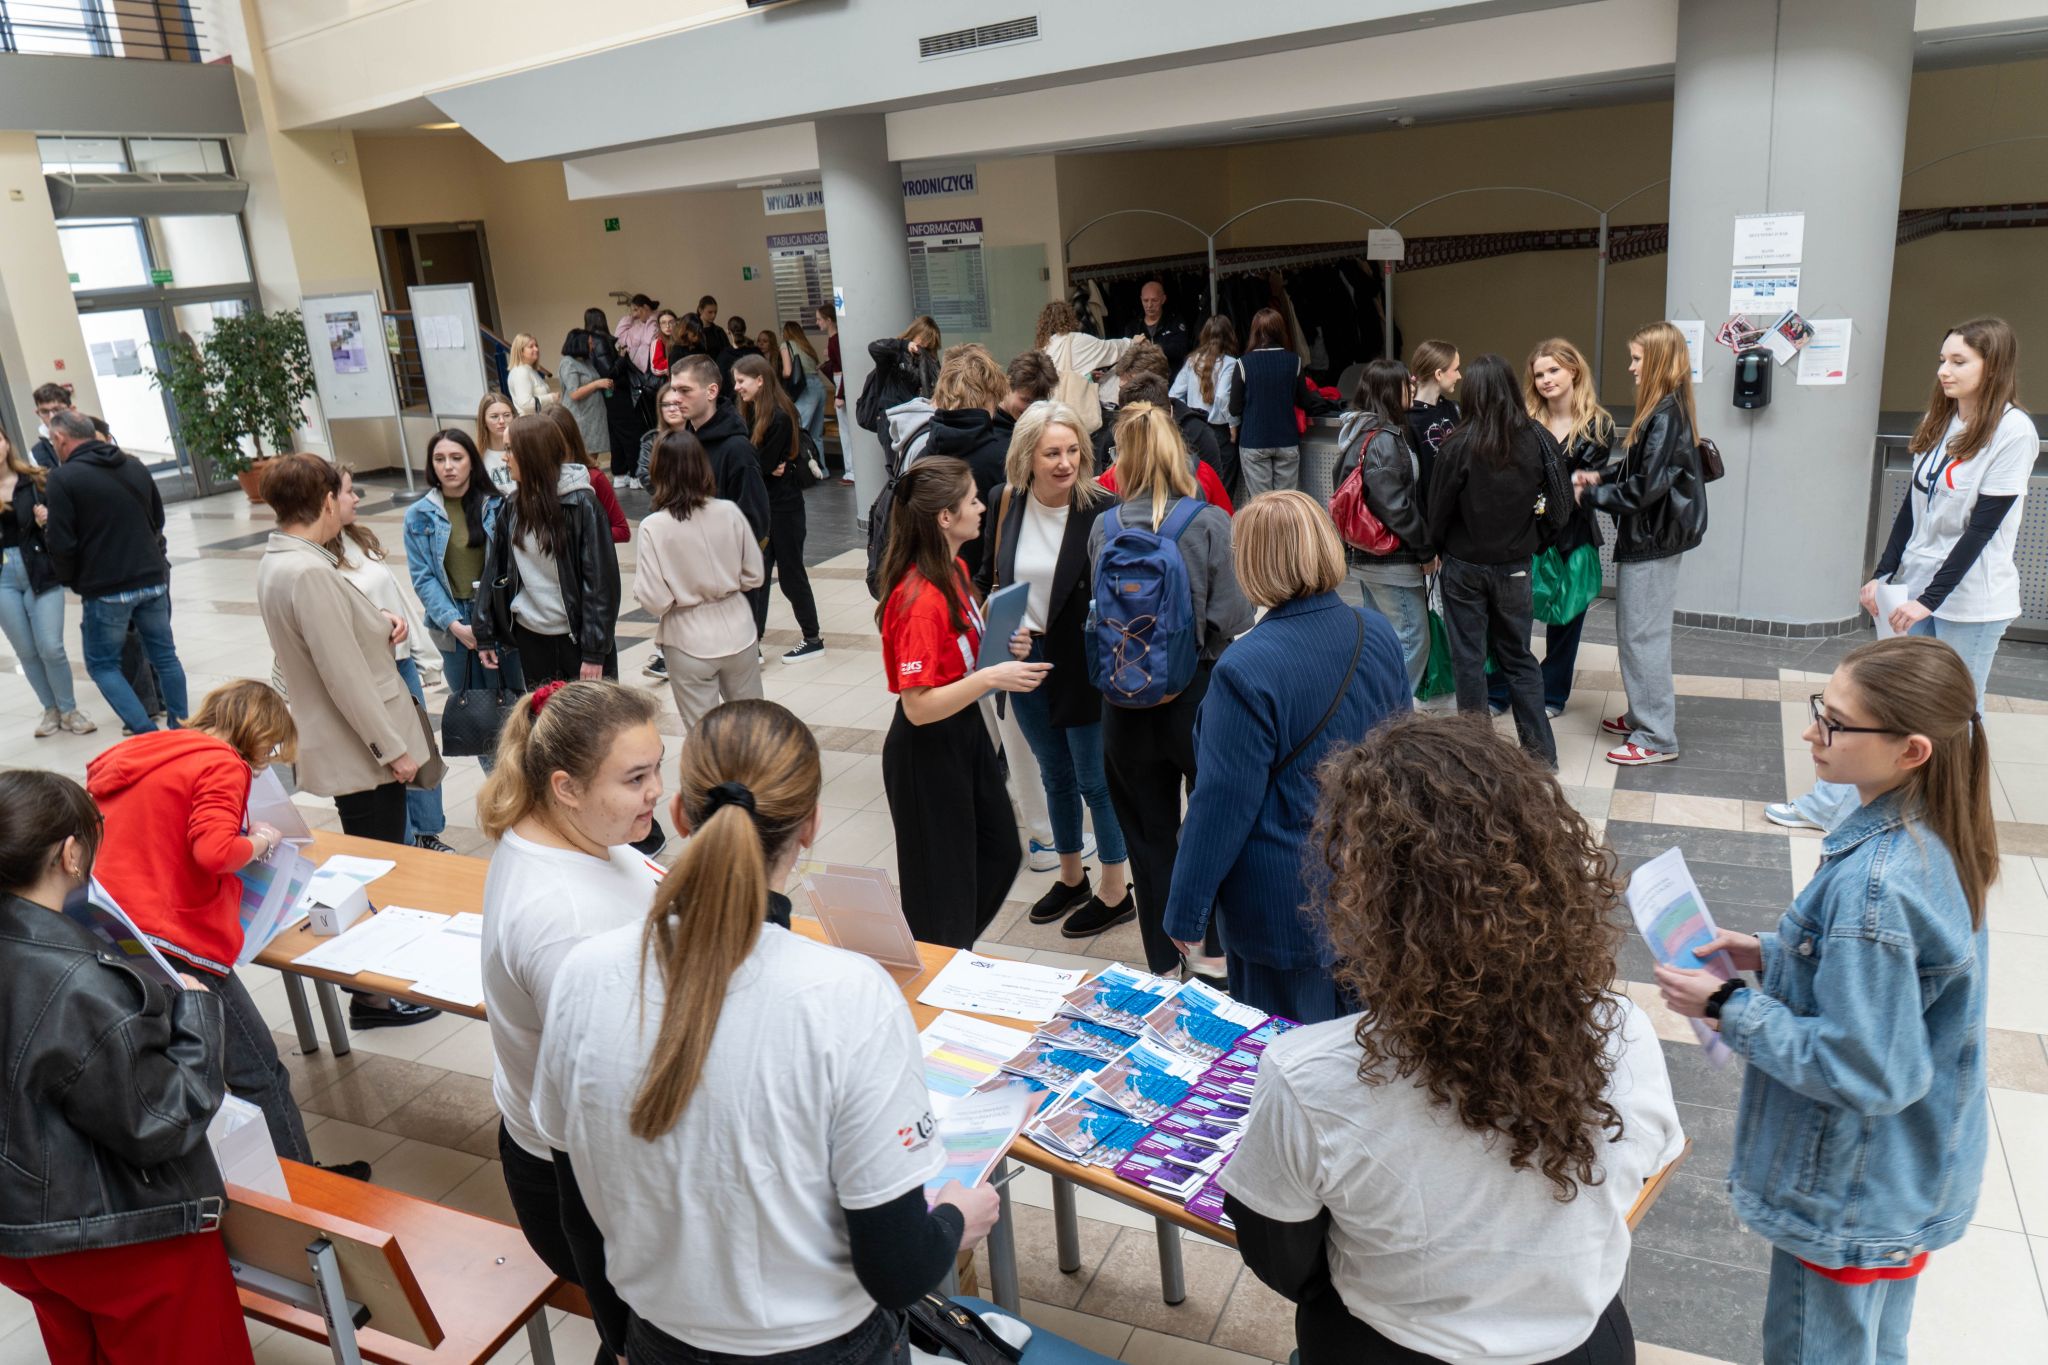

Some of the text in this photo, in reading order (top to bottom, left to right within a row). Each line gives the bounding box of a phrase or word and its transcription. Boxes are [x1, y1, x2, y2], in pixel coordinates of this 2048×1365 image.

[807, 188, 825, 207] NAU
[902, 174, 974, 196] YRODNICZYCH
[909, 220, 977, 236] INFORMACYJNA
[771, 233, 802, 248] TABLICA
